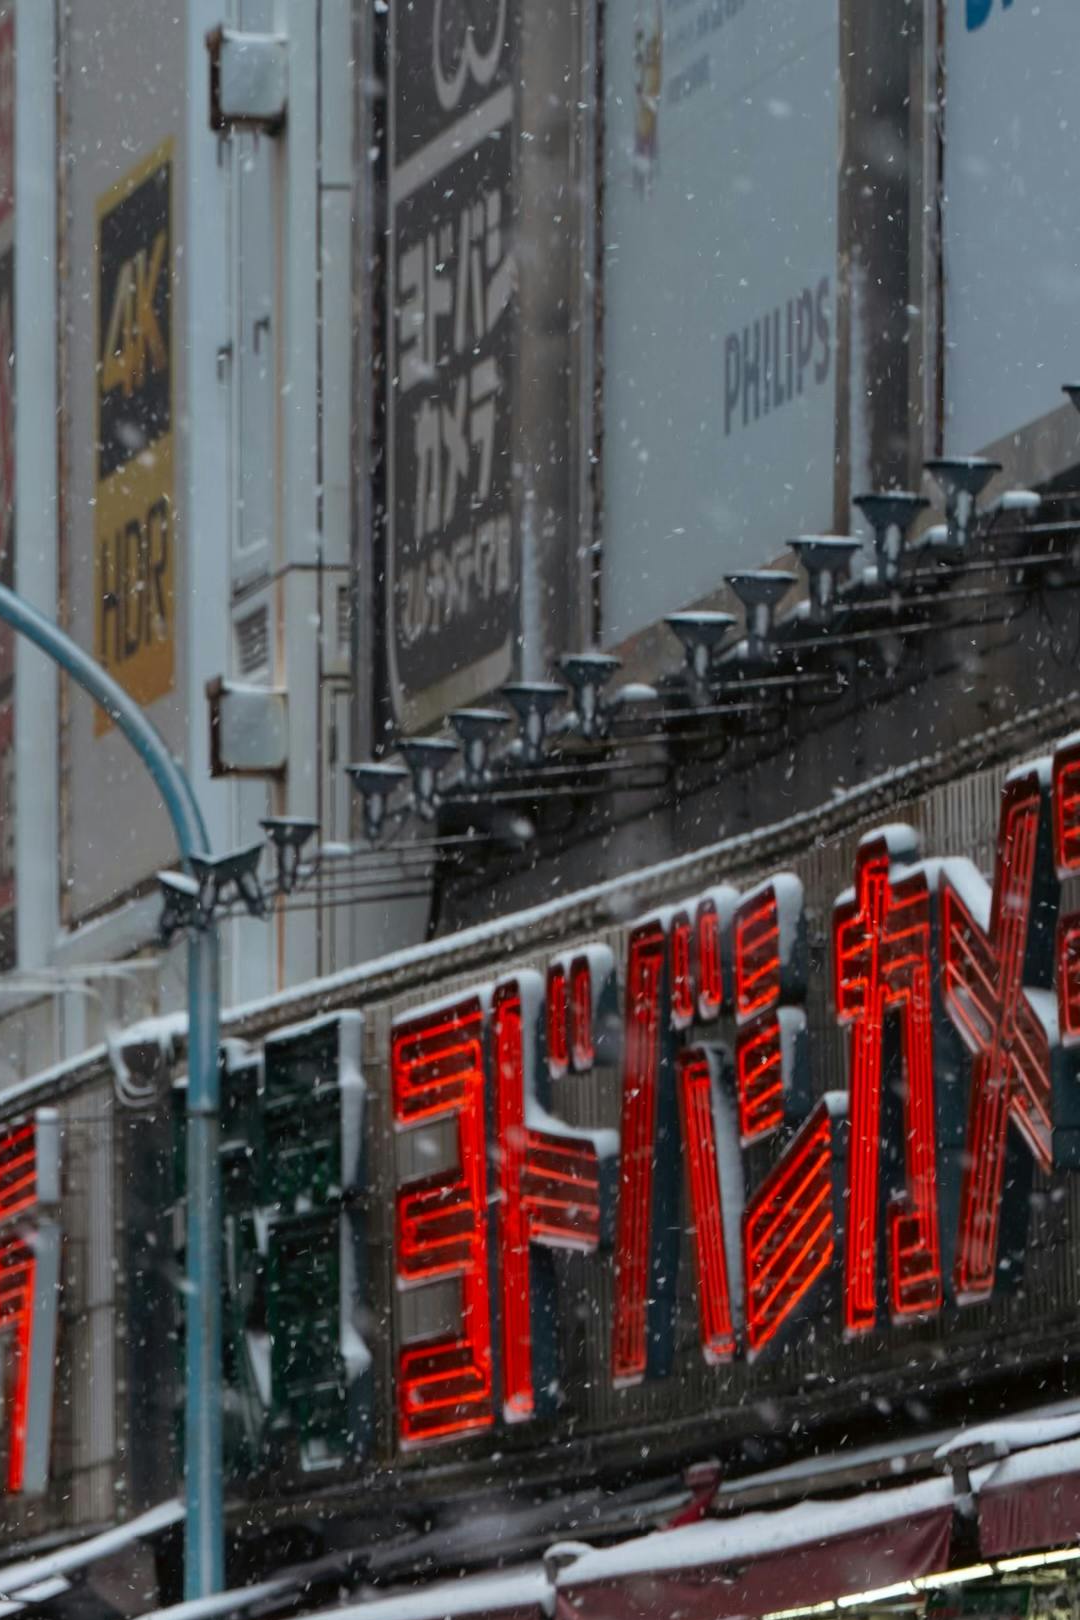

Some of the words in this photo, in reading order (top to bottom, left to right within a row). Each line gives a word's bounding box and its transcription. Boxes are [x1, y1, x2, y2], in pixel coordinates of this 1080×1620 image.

[102, 229, 167, 398] 4K
[723, 275, 831, 437] PHILIPS
[414, 355, 503, 541] カメラ
[101, 494, 168, 668] HDR
